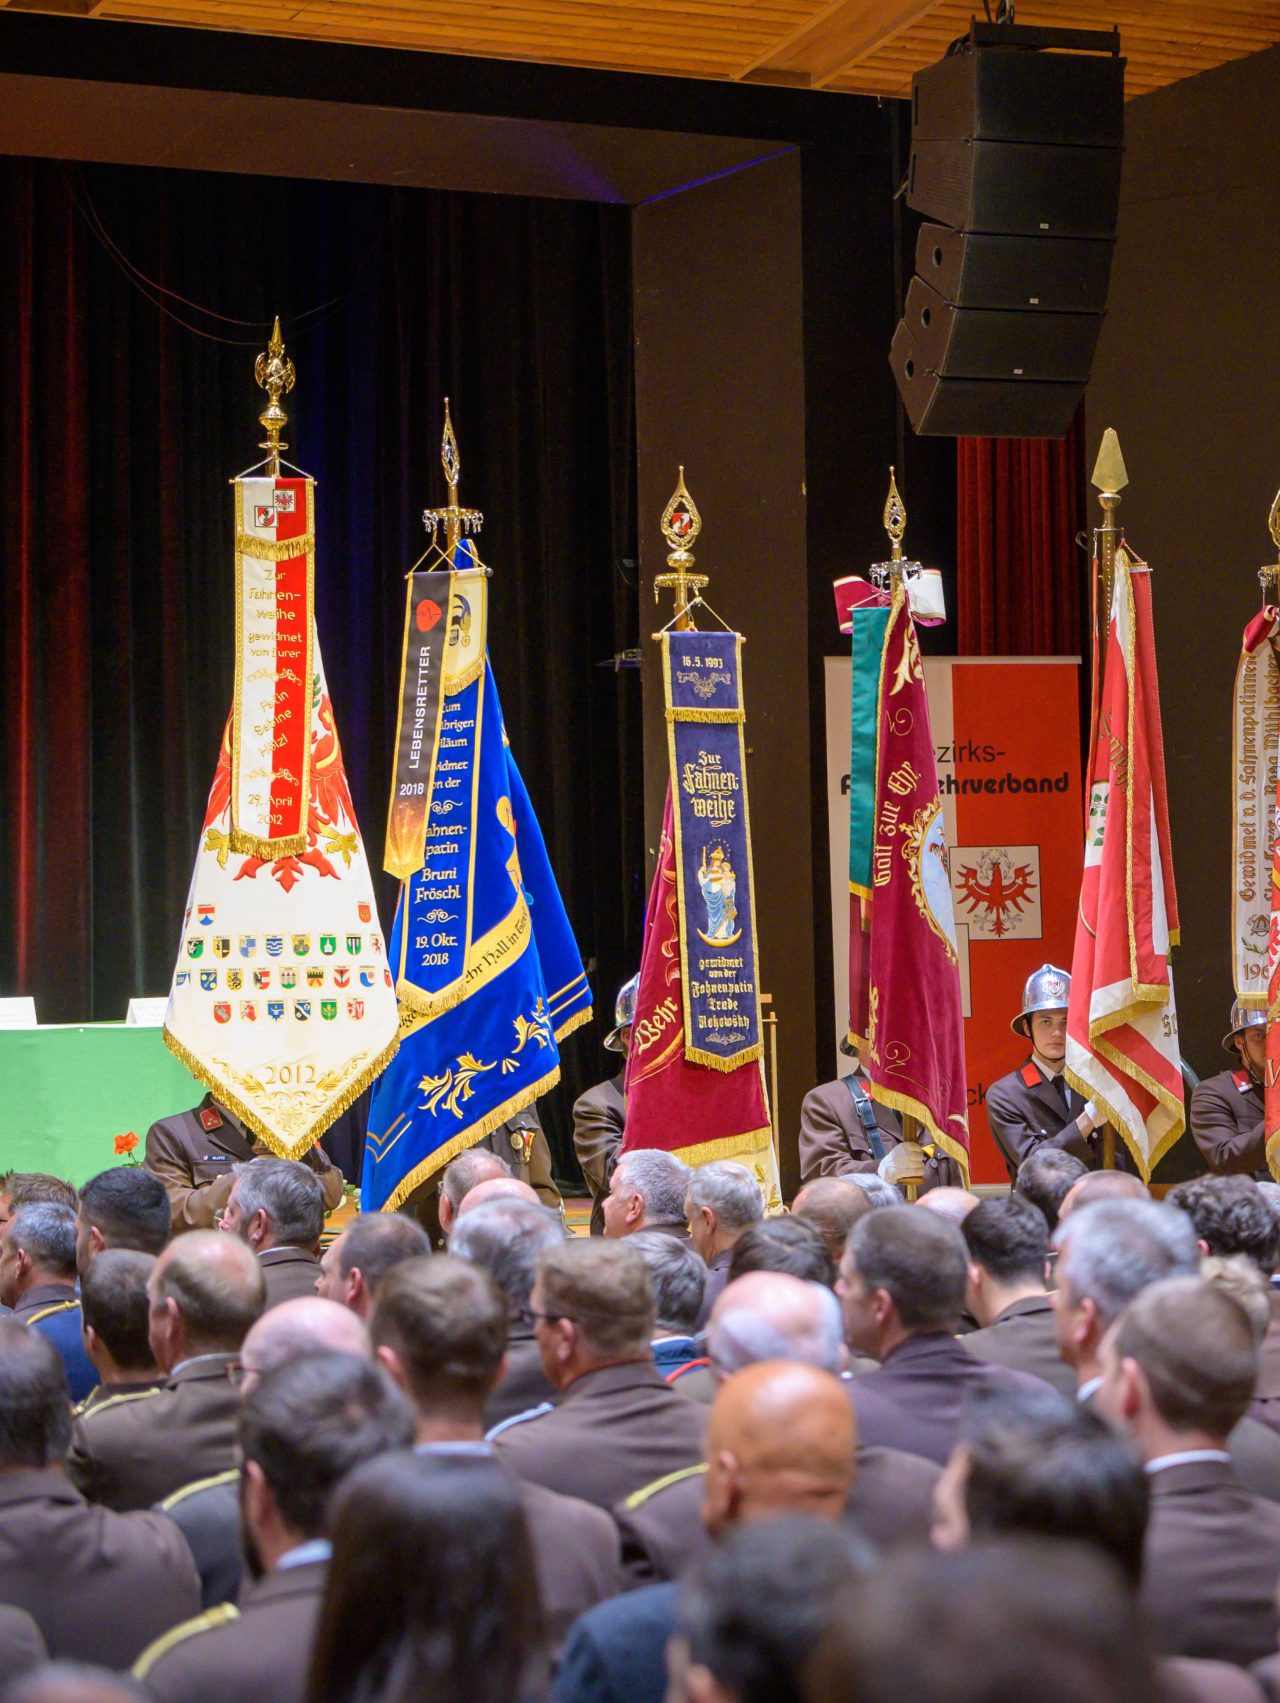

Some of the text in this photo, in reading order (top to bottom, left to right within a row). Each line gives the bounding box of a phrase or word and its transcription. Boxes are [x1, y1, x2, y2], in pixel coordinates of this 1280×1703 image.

[264, 569, 286, 580] Zur
[248, 587, 302, 600] Fahnen-
[248, 632, 303, 643] gewidmet
[250, 649, 269, 657] von
[260, 690, 289, 712] Patin
[409, 646, 431, 769] LEBENSRETTER
[253, 709, 293, 736] Sabine
[440, 738, 468, 748] iläum
[698, 751, 722, 764] Zur
[933, 740, 1006, 763] zirks-
[399, 783, 425, 796] 2018
[444, 777, 462, 788] der
[247, 794, 293, 808] 29. April
[257, 813, 283, 825] 2012
[878, 800, 901, 837] zur
[426, 823, 468, 837] ahnen-
[425, 842, 459, 859] patin
[874, 845, 893, 887] Gott
[1239, 822, 1257, 902] Gewidmet
[421, 867, 457, 882] Bruni
[414, 885, 462, 904] Fröschl
[415, 936, 429, 948] 19.
[482, 940, 511, 966] Hall
[506, 932, 519, 945] in
[421, 953, 449, 966] 2018
[698, 956, 744, 970] gewidmet
[724, 968, 737, 978] der
[691, 980, 754, 998] Fahnenpatin
[635, 996, 679, 1055] Wehr
[265, 1064, 316, 1084] 2012
